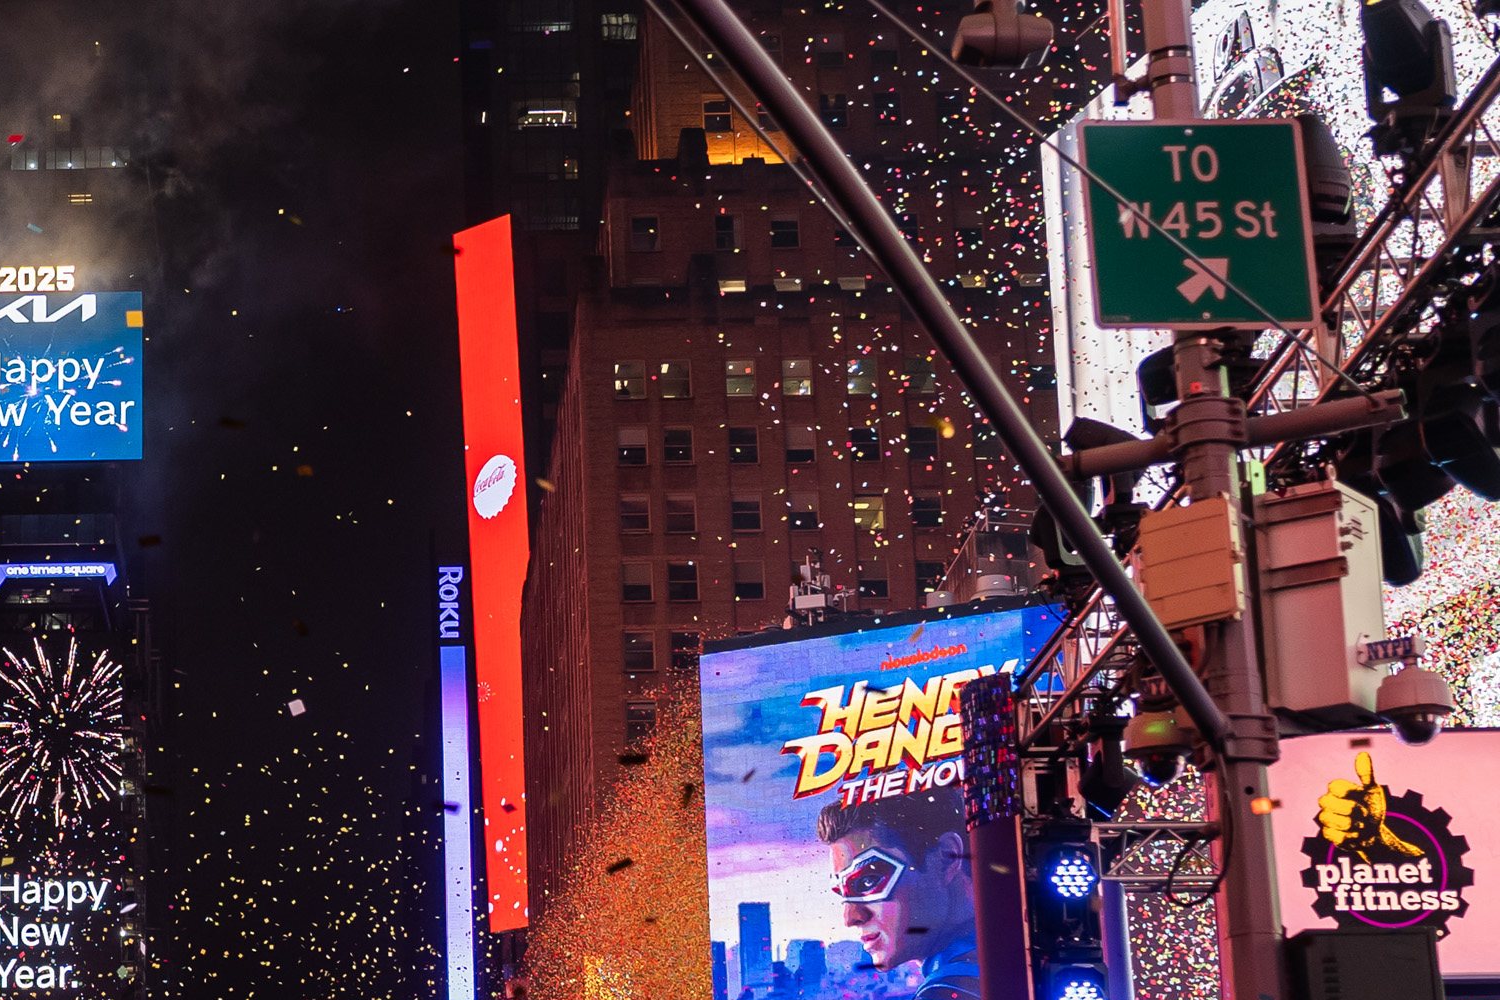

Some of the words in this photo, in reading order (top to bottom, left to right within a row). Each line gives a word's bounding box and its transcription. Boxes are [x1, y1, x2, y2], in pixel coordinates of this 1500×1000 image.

[1163, 145, 1218, 182] TO
[1118, 203, 1149, 238] W
[1162, 202, 1221, 238] 45
[1235, 201, 1277, 238] St
[45, 394, 134, 426] Year
[6, 565, 28, 575] one
[30, 564, 62, 575] times
[64, 564, 105, 577] square
[881, 644, 967, 671] nickelodeon
[781, 713, 964, 799] DANG
[841, 771, 905, 807] THE
[909, 759, 965, 793] MOV
[1316, 856, 1433, 893] planet
[1334, 885, 1459, 912] fitness
